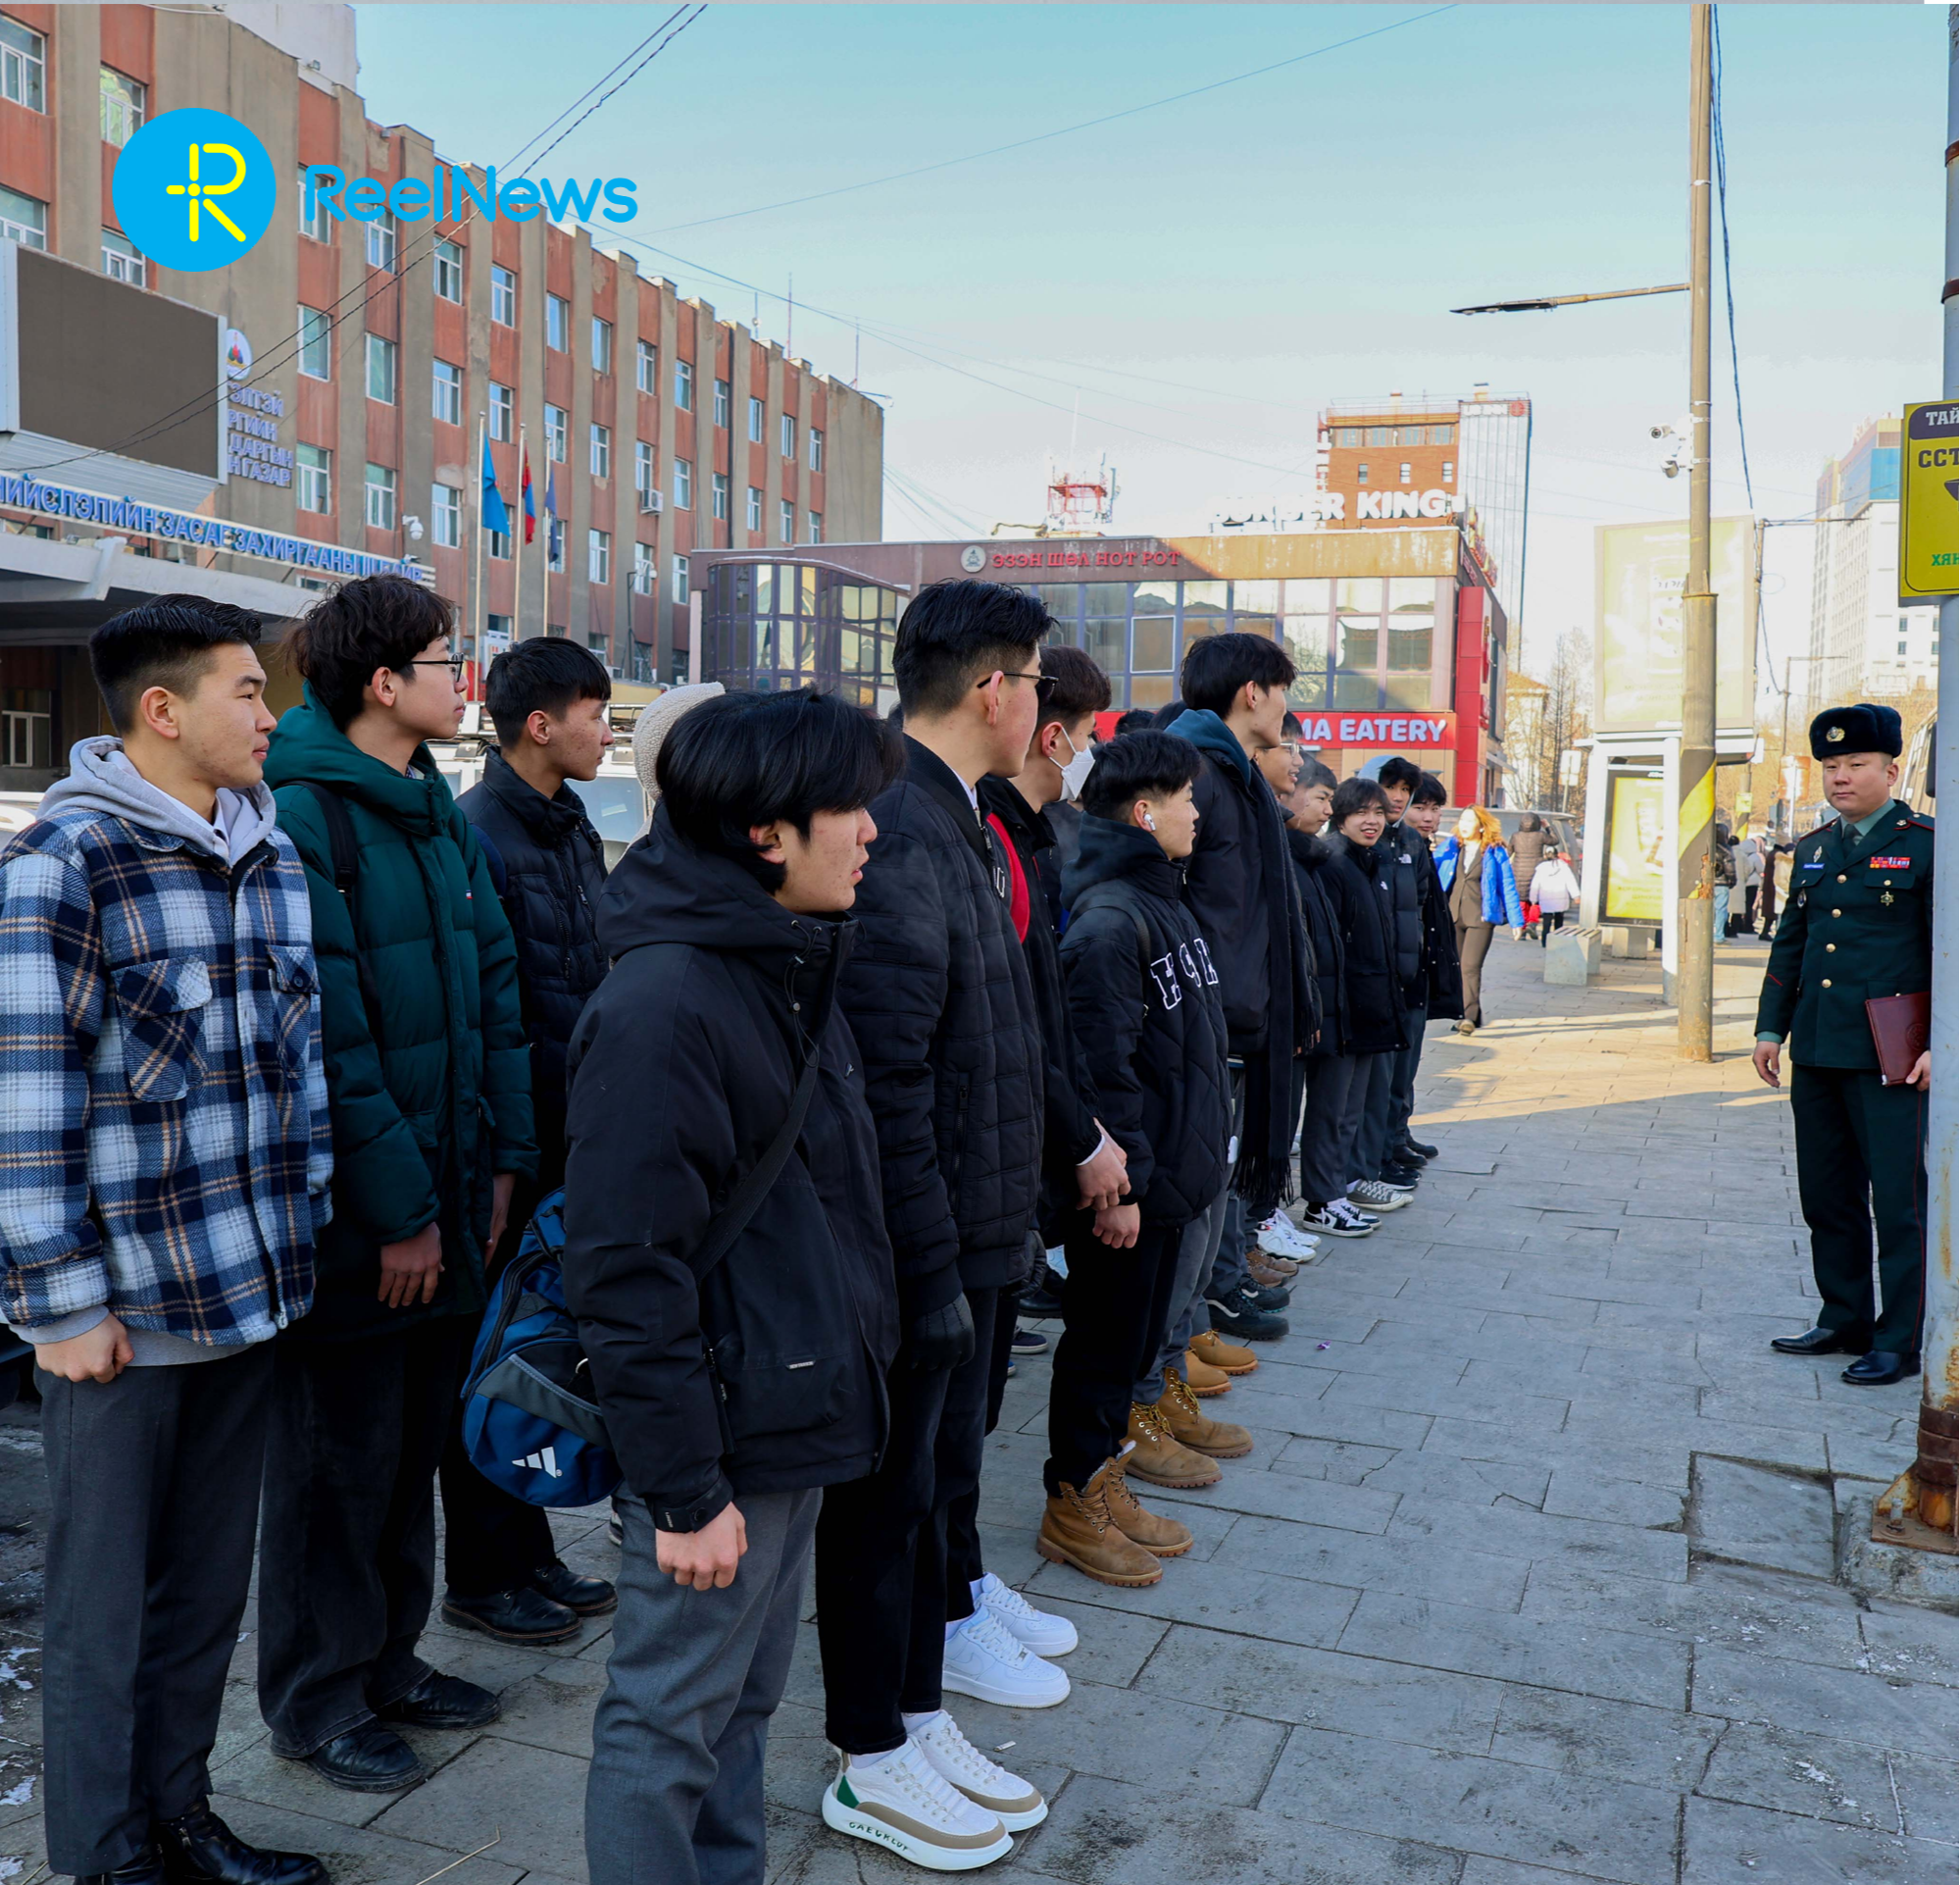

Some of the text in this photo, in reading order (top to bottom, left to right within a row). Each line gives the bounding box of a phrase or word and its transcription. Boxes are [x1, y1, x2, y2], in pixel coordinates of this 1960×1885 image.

[241, 457, 291, 487] ГАЗАР
[1357, 489, 1446, 520] KING
[234, 529, 358, 576] ЗАХИРГААНЫ
[992, 552, 1043, 568] ЭЗЭН
[1047, 551, 1091, 567] ШӨЛ
[1339, 718, 1446, 742] EATERY
